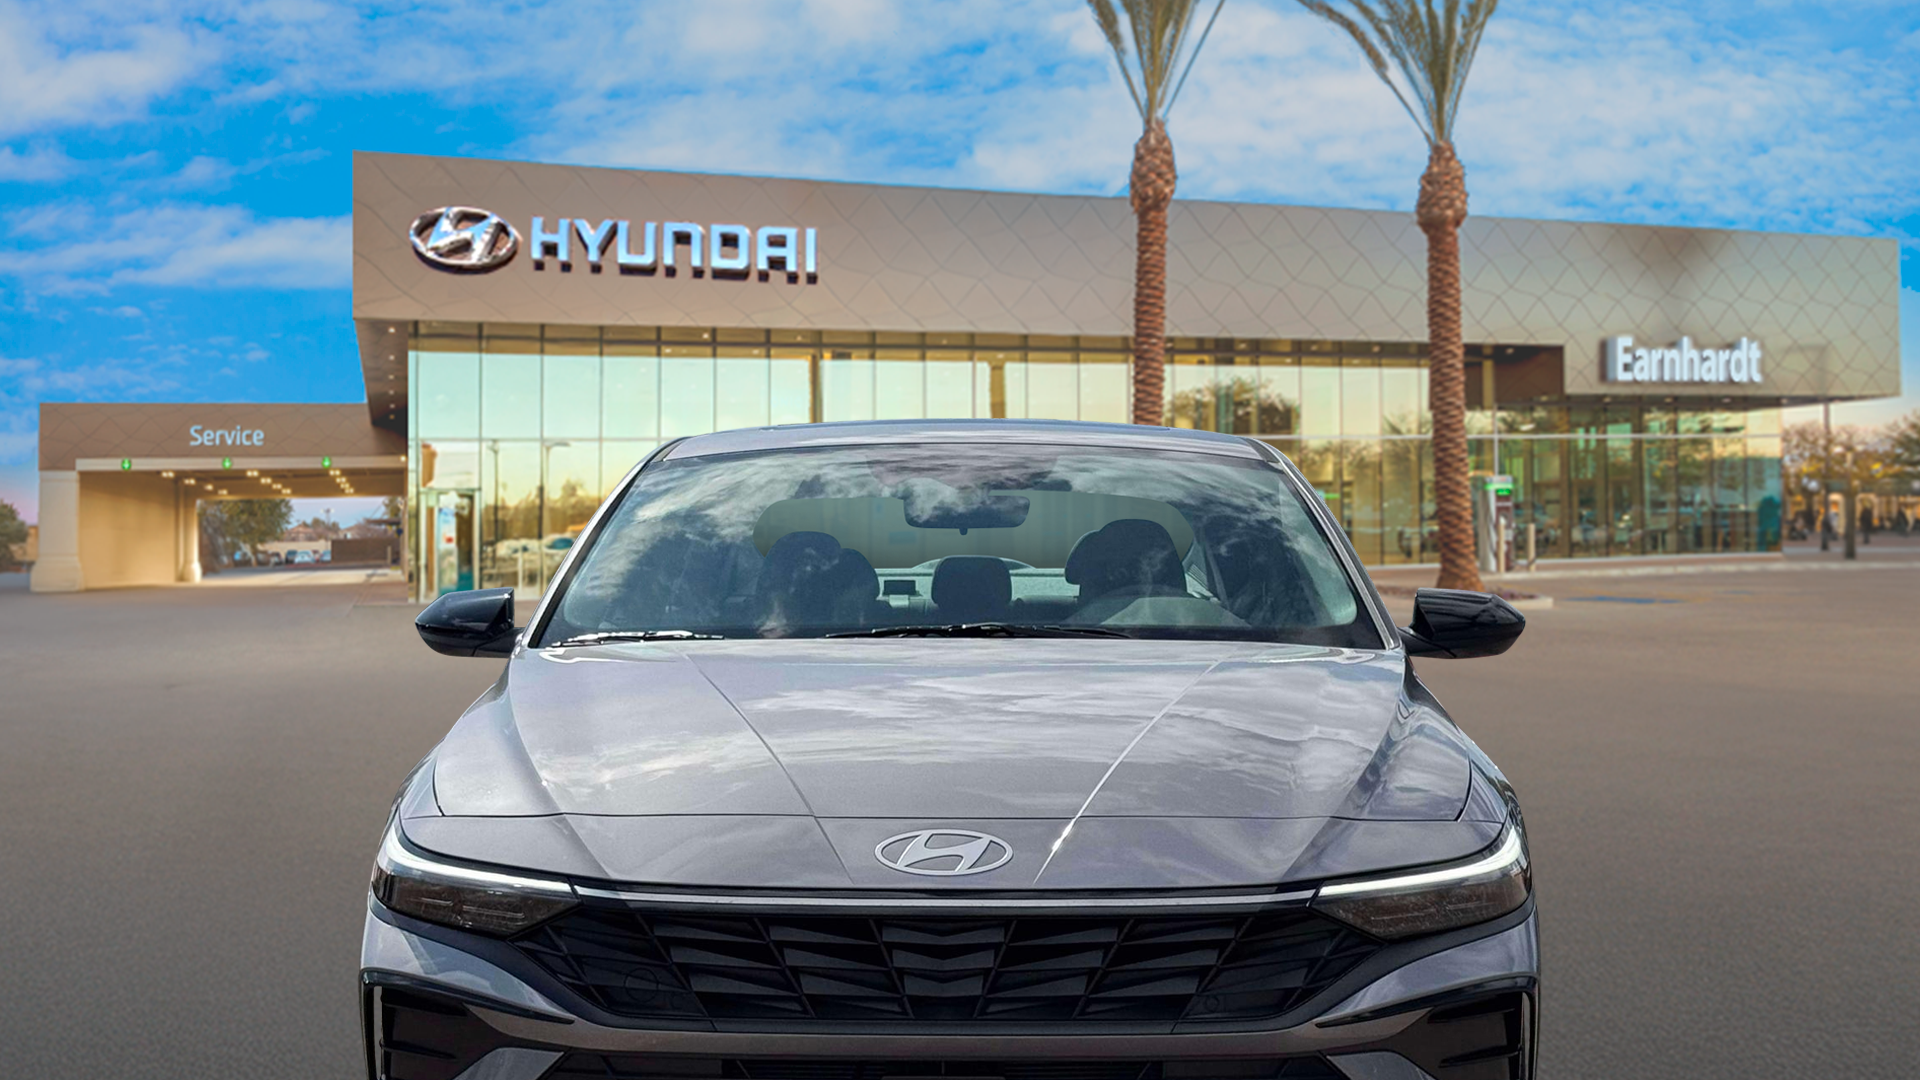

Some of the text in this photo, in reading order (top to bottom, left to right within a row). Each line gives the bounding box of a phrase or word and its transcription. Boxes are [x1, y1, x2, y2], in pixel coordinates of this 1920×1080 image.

[530, 215, 817, 279] HYUNDAI
[1611, 335, 1763, 383] Earnhardt
[189, 424, 265, 447] Service
